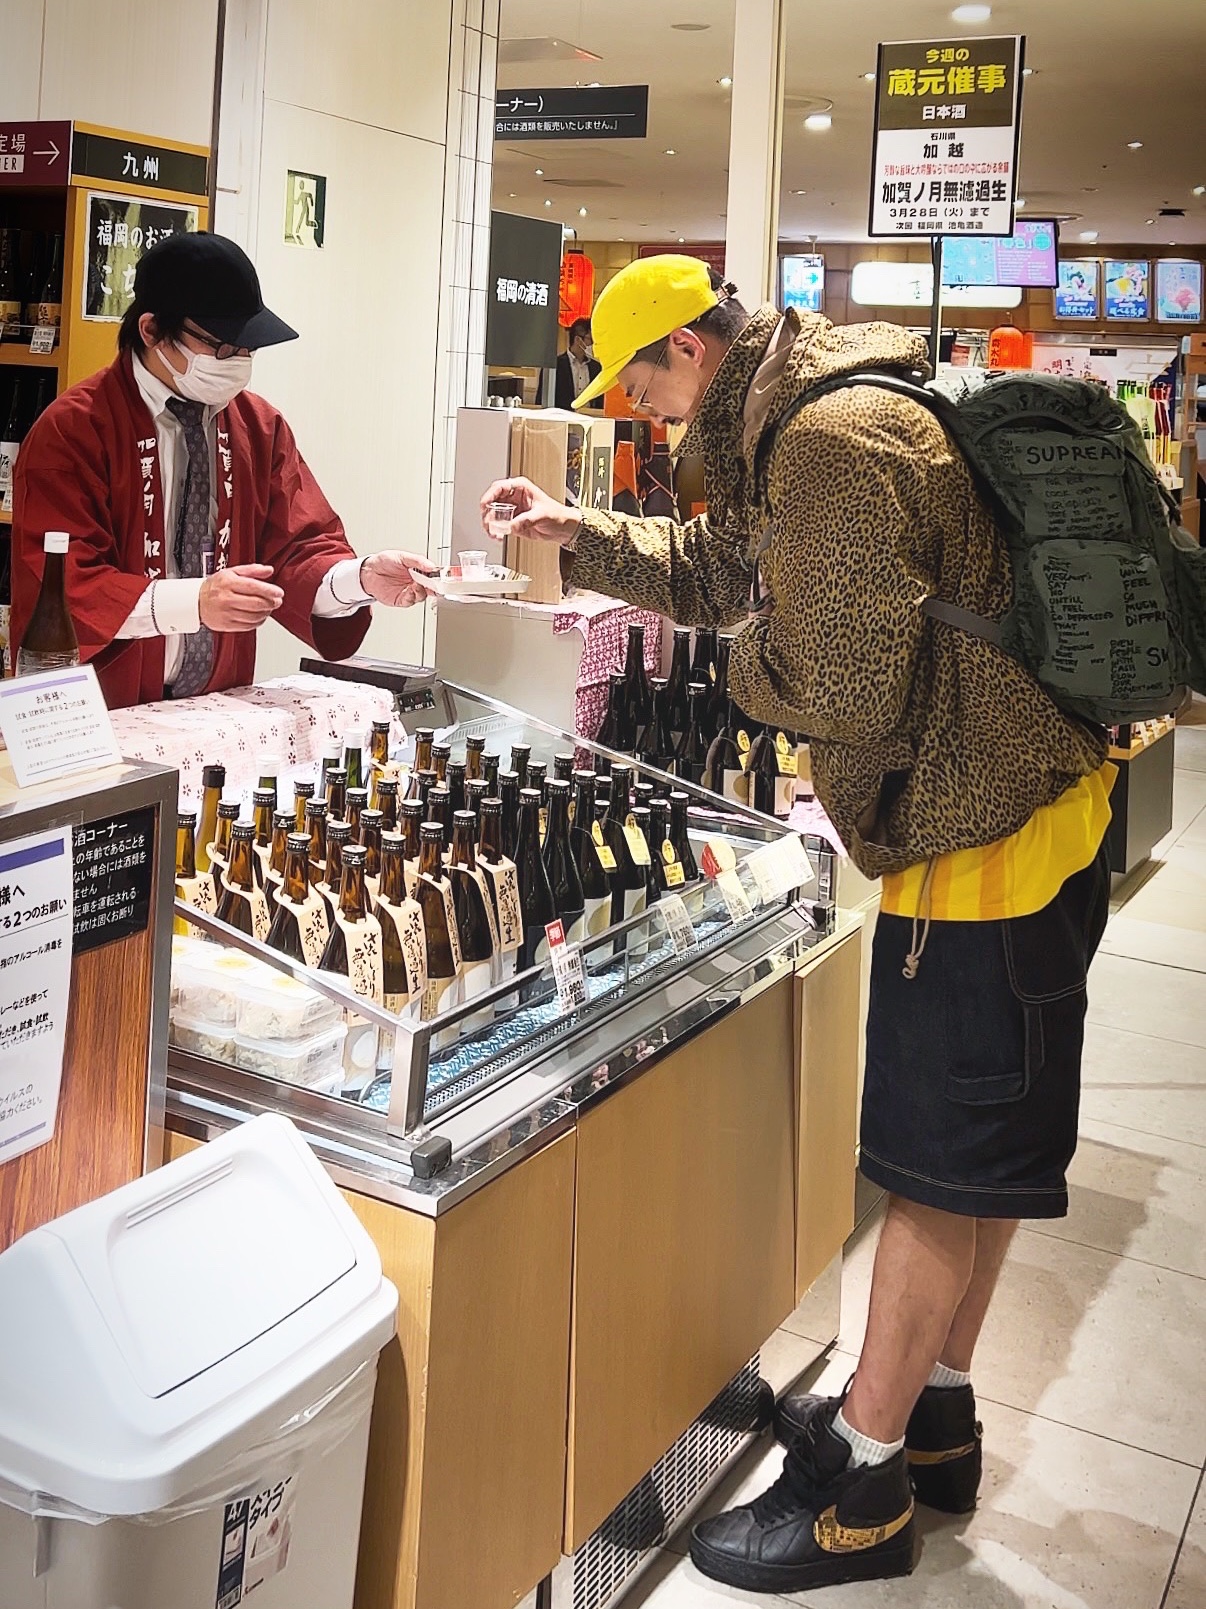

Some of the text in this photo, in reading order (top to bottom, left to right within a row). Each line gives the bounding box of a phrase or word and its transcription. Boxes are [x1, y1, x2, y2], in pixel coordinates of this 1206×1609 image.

[926, 48, 970, 63] 今週の
[888, 65, 1007, 97] 蔵元催事
[922, 104, 967, 120] 日本酒
[930, 132, 956, 141] 石川県
[0, 157, 17, 170] ER
[122, 151, 159, 181] 九州
[882, 180, 1007, 203] 加賀ノ月無濾過生
[496, 277, 549, 306] 福岡の清酒
[1123, 579, 1151, 591] FEEL
[73, 822, 128, 847] 酒コーナー
[0, 898, 67, 929] る2つのお願い
